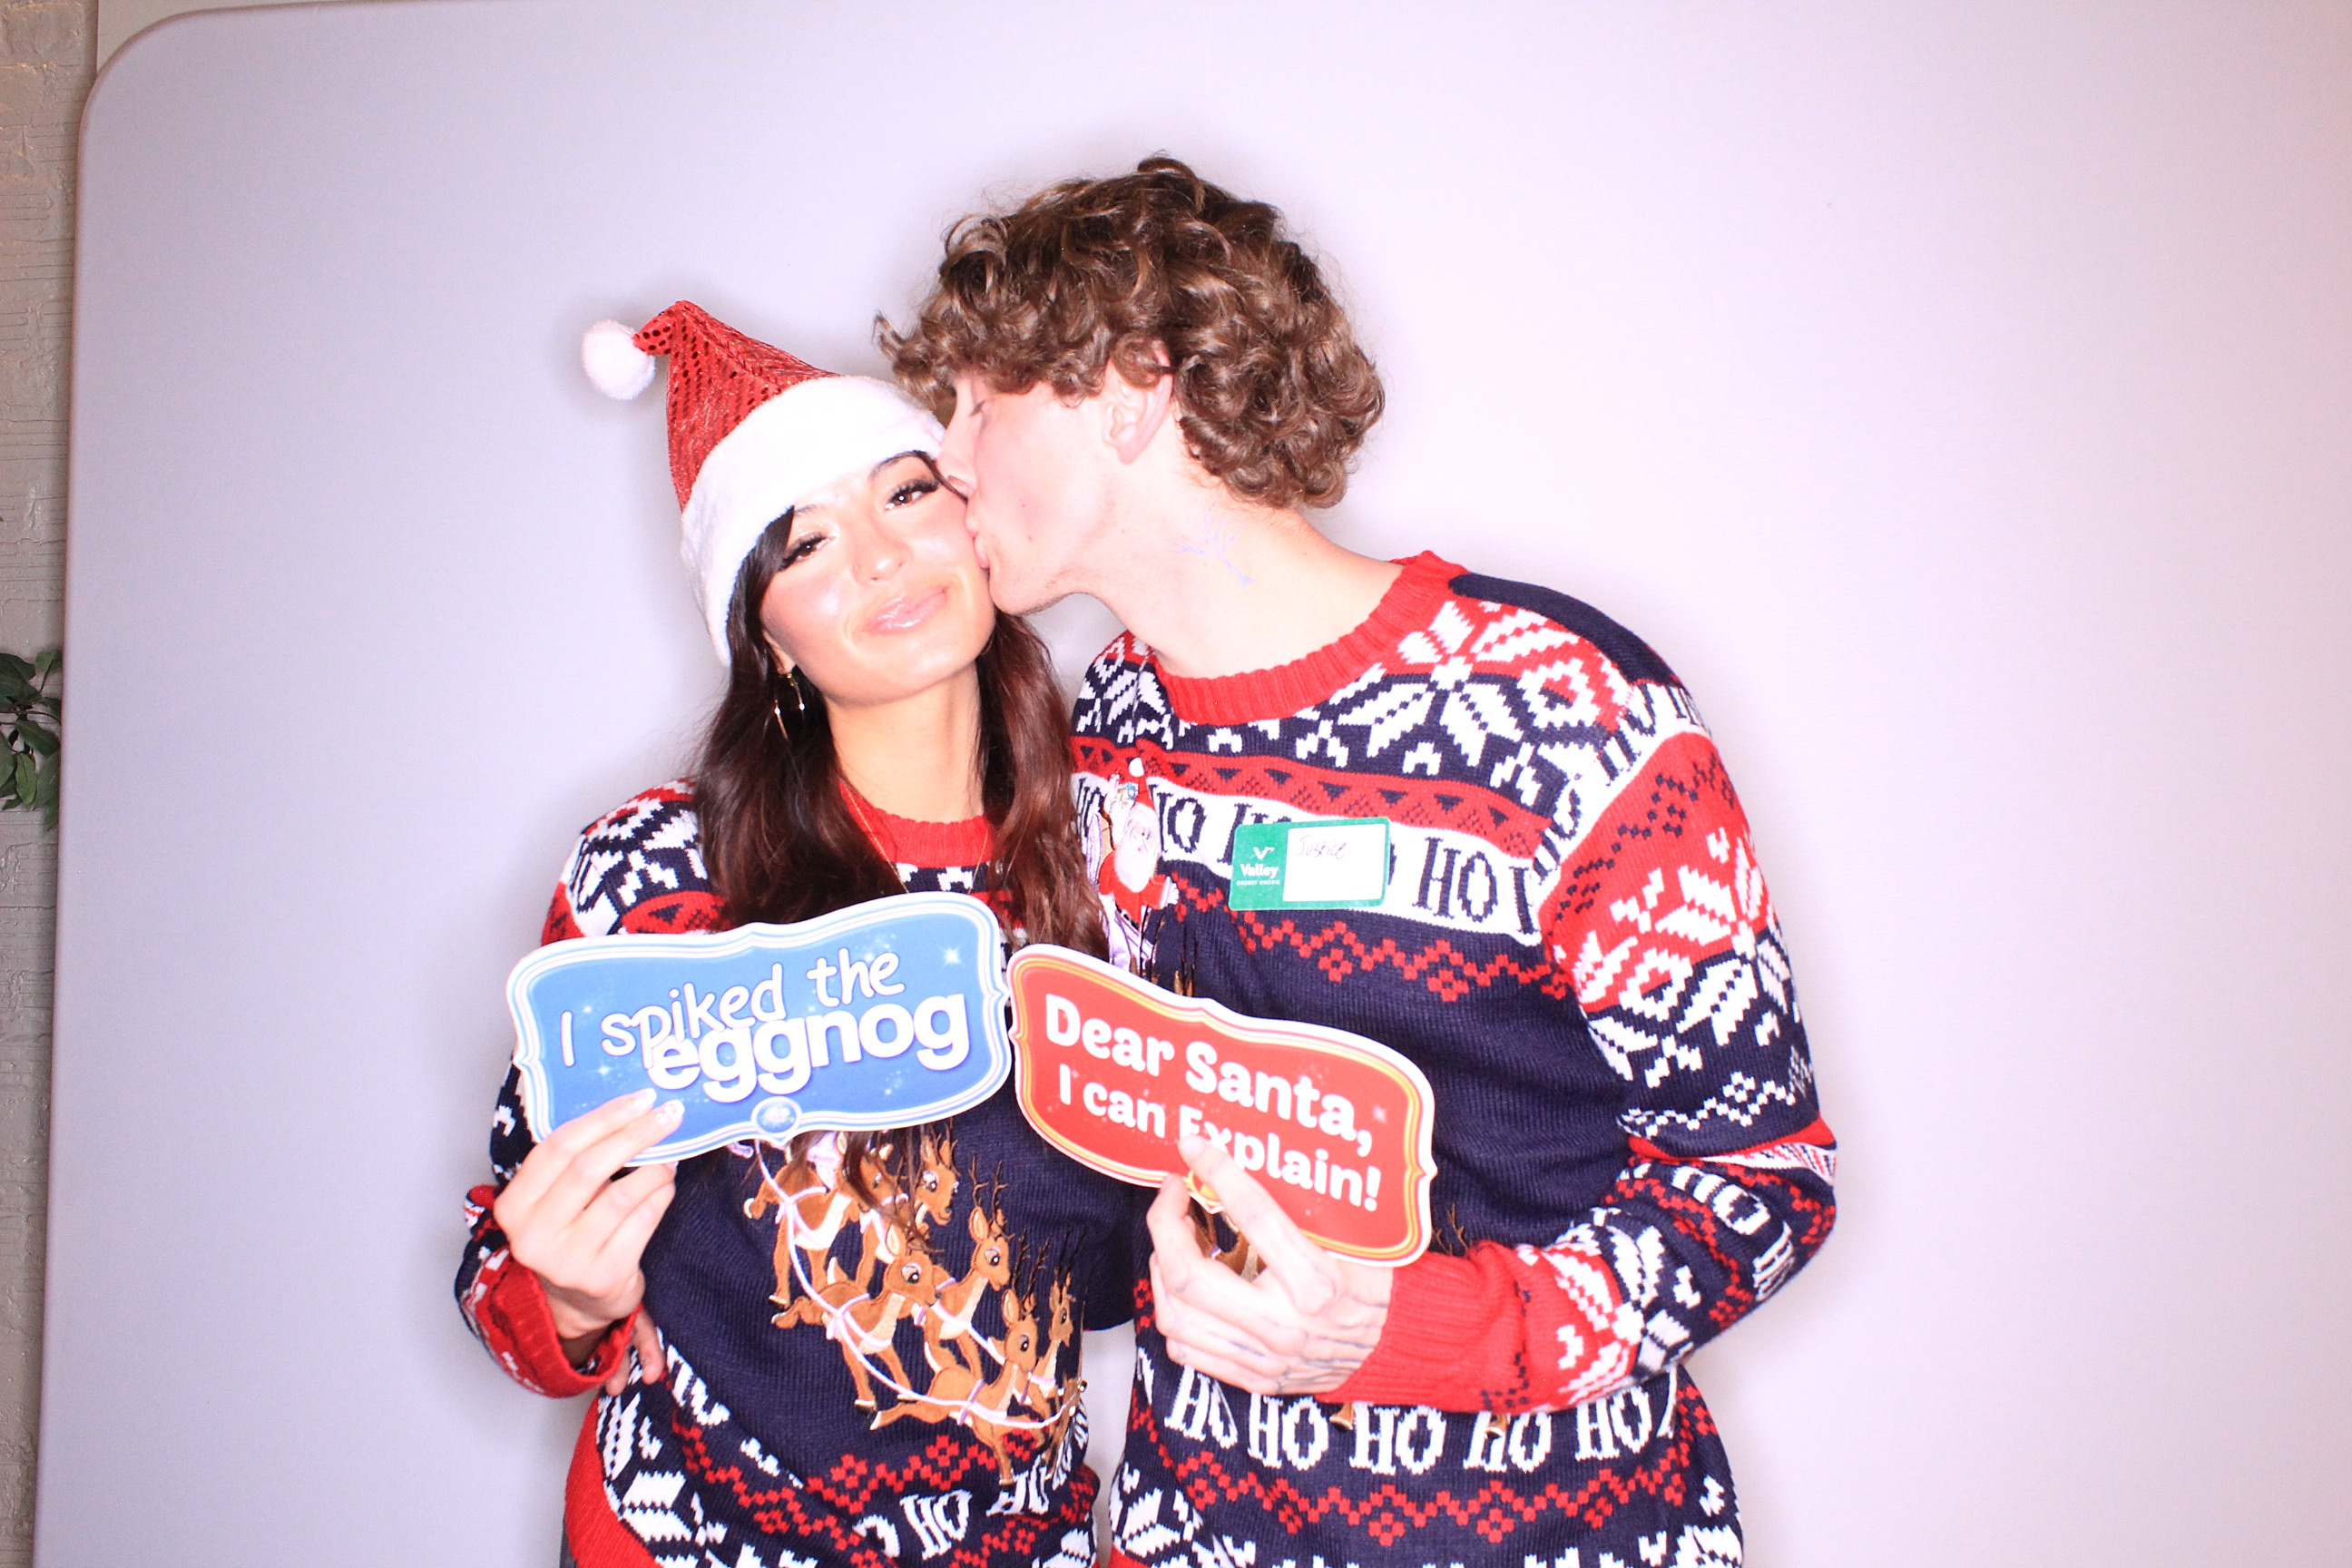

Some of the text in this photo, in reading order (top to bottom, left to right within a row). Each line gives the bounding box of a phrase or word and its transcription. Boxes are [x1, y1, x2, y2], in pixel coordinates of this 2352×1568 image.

[1240, 863, 1279, 879] Valley
[559, 946, 906, 1071] I spiked the
[645, 993, 971, 1102] eggnog
[1045, 993, 1374, 1158] Dear Santa,
[1058, 1063, 1382, 1213] I can Explain!
